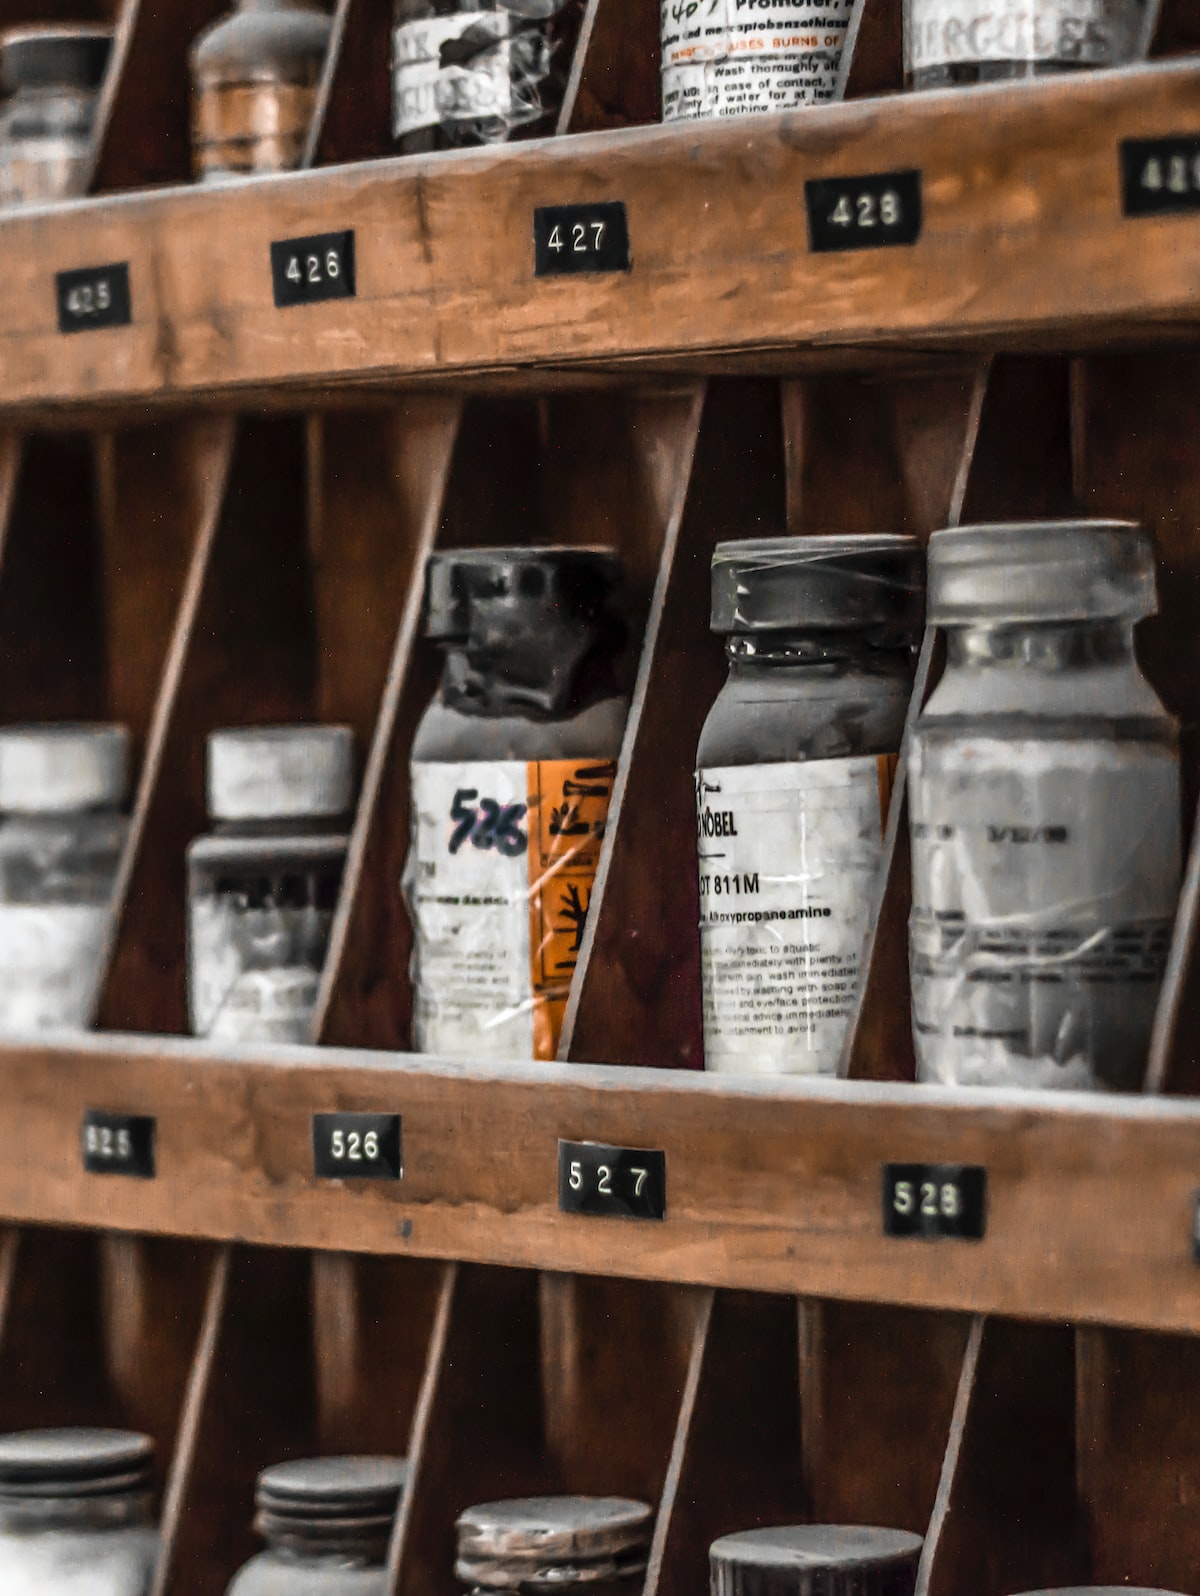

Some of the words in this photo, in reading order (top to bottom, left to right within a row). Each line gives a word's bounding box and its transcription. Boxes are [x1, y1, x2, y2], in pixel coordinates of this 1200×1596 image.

[773, 36, 819, 49] BURNS
[714, 65, 745, 77] Wash
[751, 56, 819, 74] thoroughly
[724, 82, 752, 92] case
[758, 79, 770, 89] of
[776, 77, 826, 89] contact,
[726, 93, 760, 103] water
[769, 90, 786, 100] for
[794, 90, 805, 99] at
[827, 191, 900, 227] 428
[547, 222, 604, 252] 427
[286, 251, 339, 284] 426
[448, 788, 528, 857] 526
[701, 811, 738, 838] NOBEL
[714, 873, 759, 895] 811M
[768, 970, 795, 981] wash
[331, 1129, 379, 1160] 526
[892, 1180, 961, 1217] 528
